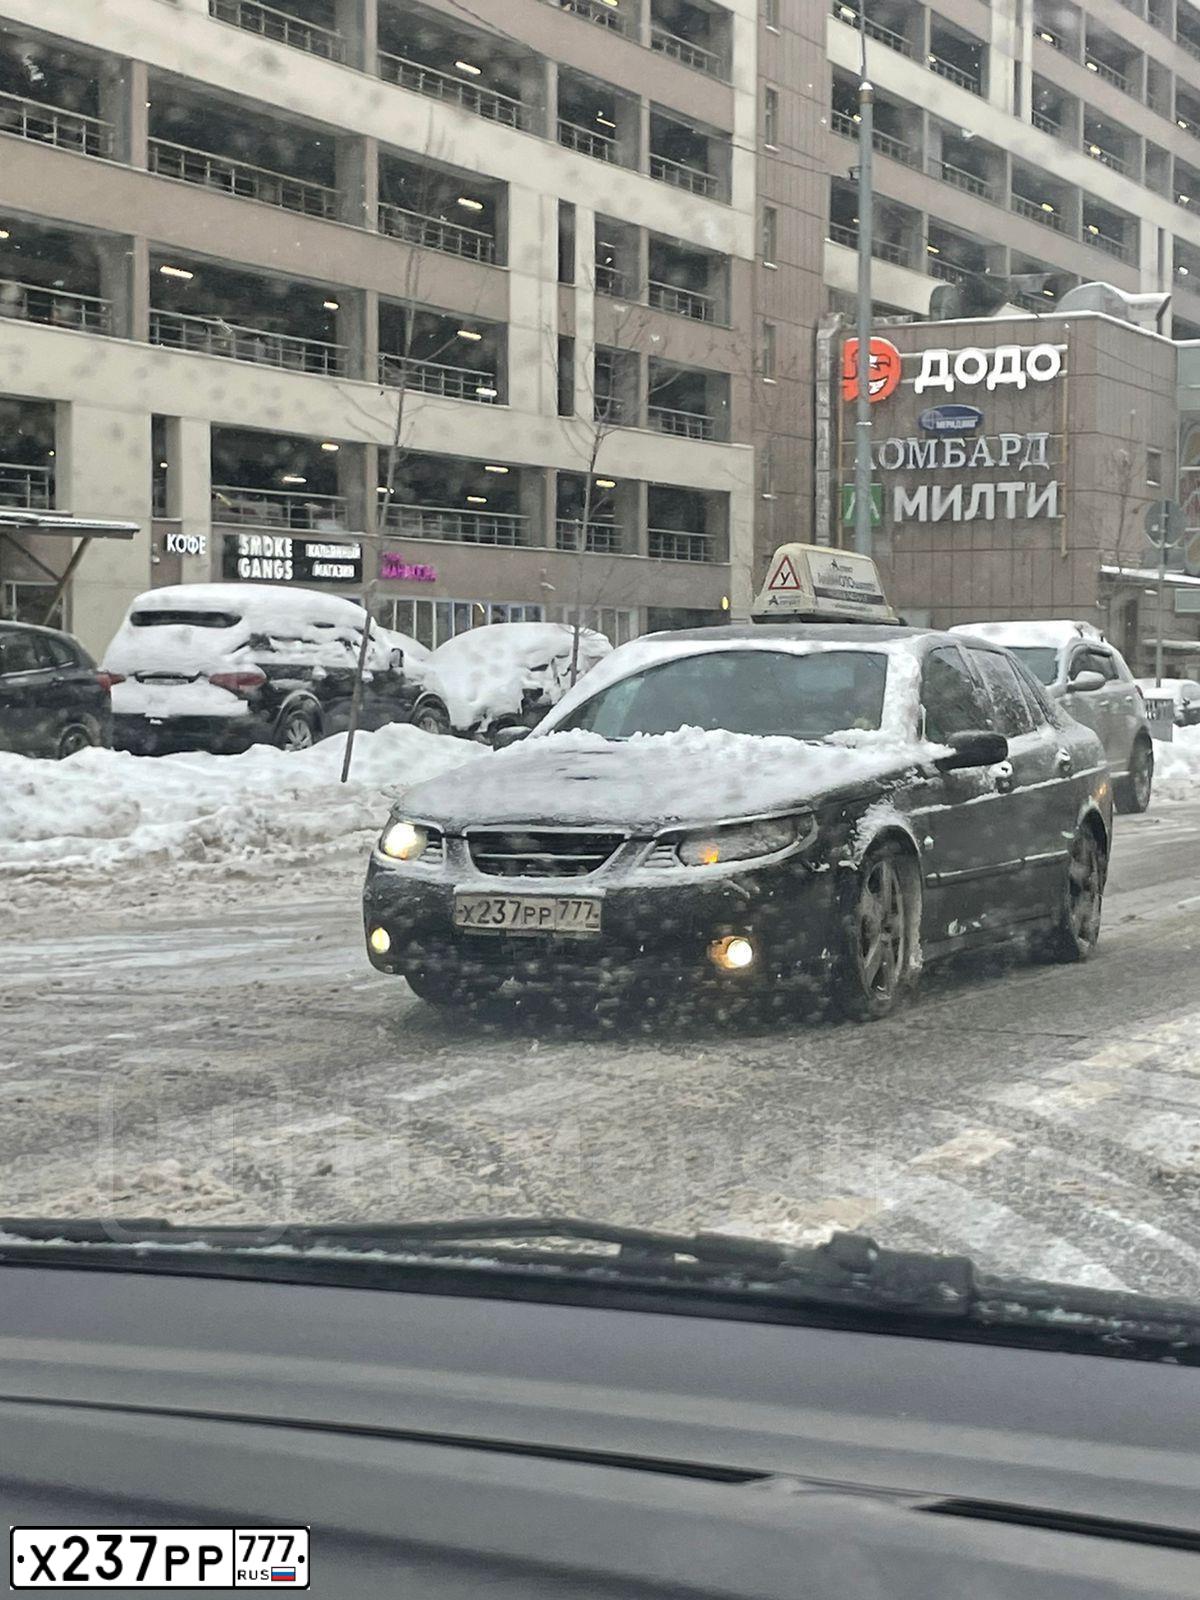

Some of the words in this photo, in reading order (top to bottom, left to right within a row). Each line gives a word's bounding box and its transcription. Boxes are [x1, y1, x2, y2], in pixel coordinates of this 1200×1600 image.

[914, 343, 1061, 394] ДОДО
[853, 432, 1050, 471] ОМБАРД
[893, 480, 1058, 523] МИЛТИ
[165, 533, 207, 555] КОФЕ
[238, 533, 293, 558] SMOKE
[238, 557, 294, 580] GANGS
[462, 899, 551, 925] Х237РР
[558, 900, 594, 920] 777
